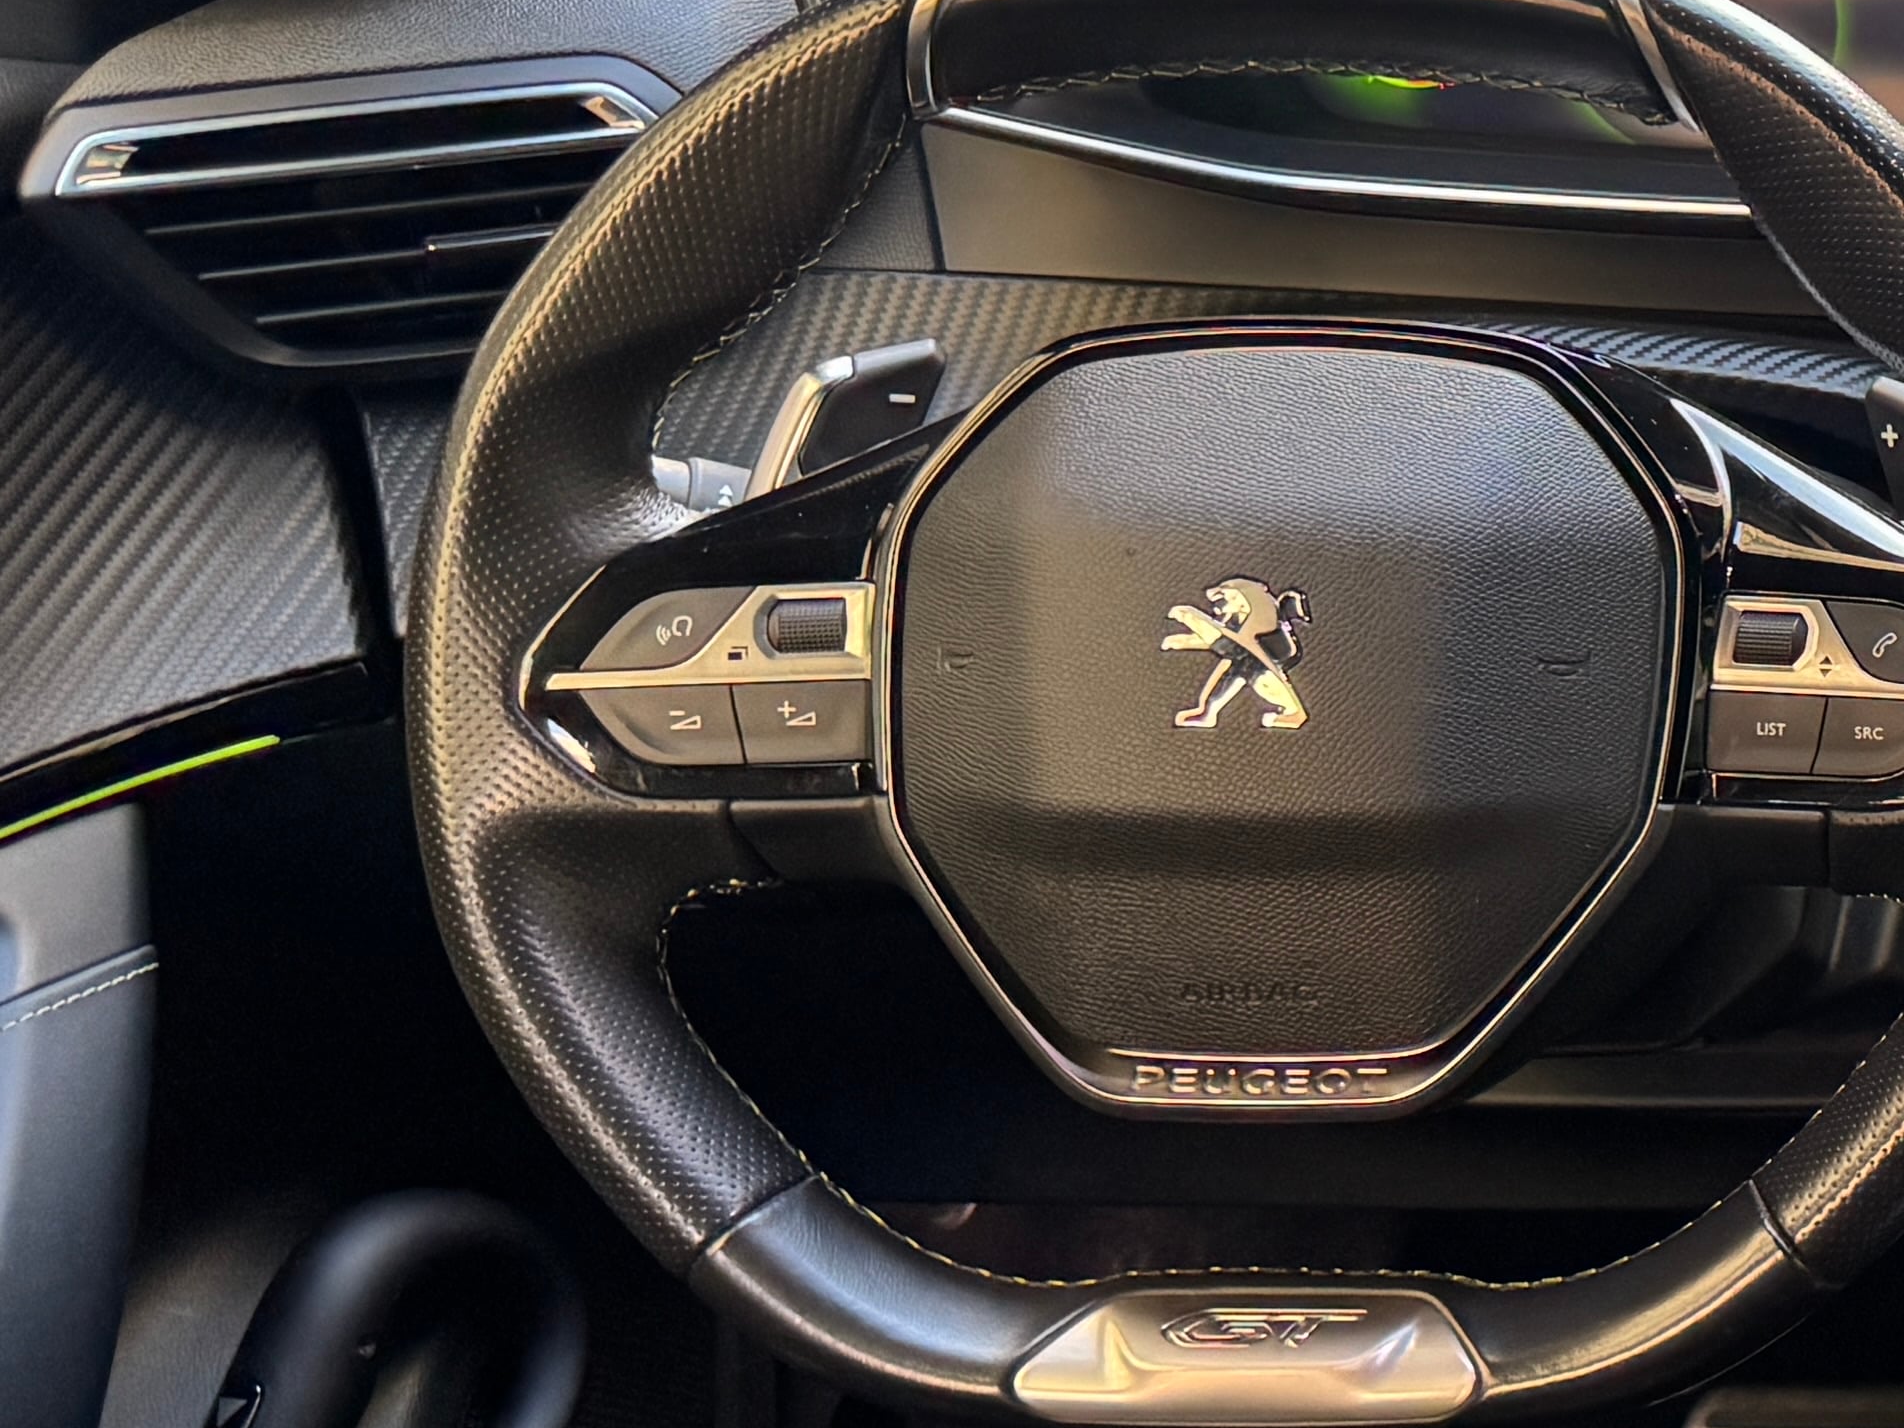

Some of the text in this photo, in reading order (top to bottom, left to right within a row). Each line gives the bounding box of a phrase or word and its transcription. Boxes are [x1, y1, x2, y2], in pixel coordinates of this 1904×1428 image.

[1756, 721, 1787, 737] LIST
[1854, 725, 1885, 740] SRC
[1131, 1065, 1388, 1095] PEUGEOT
[1160, 1307, 1368, 1349] GT
